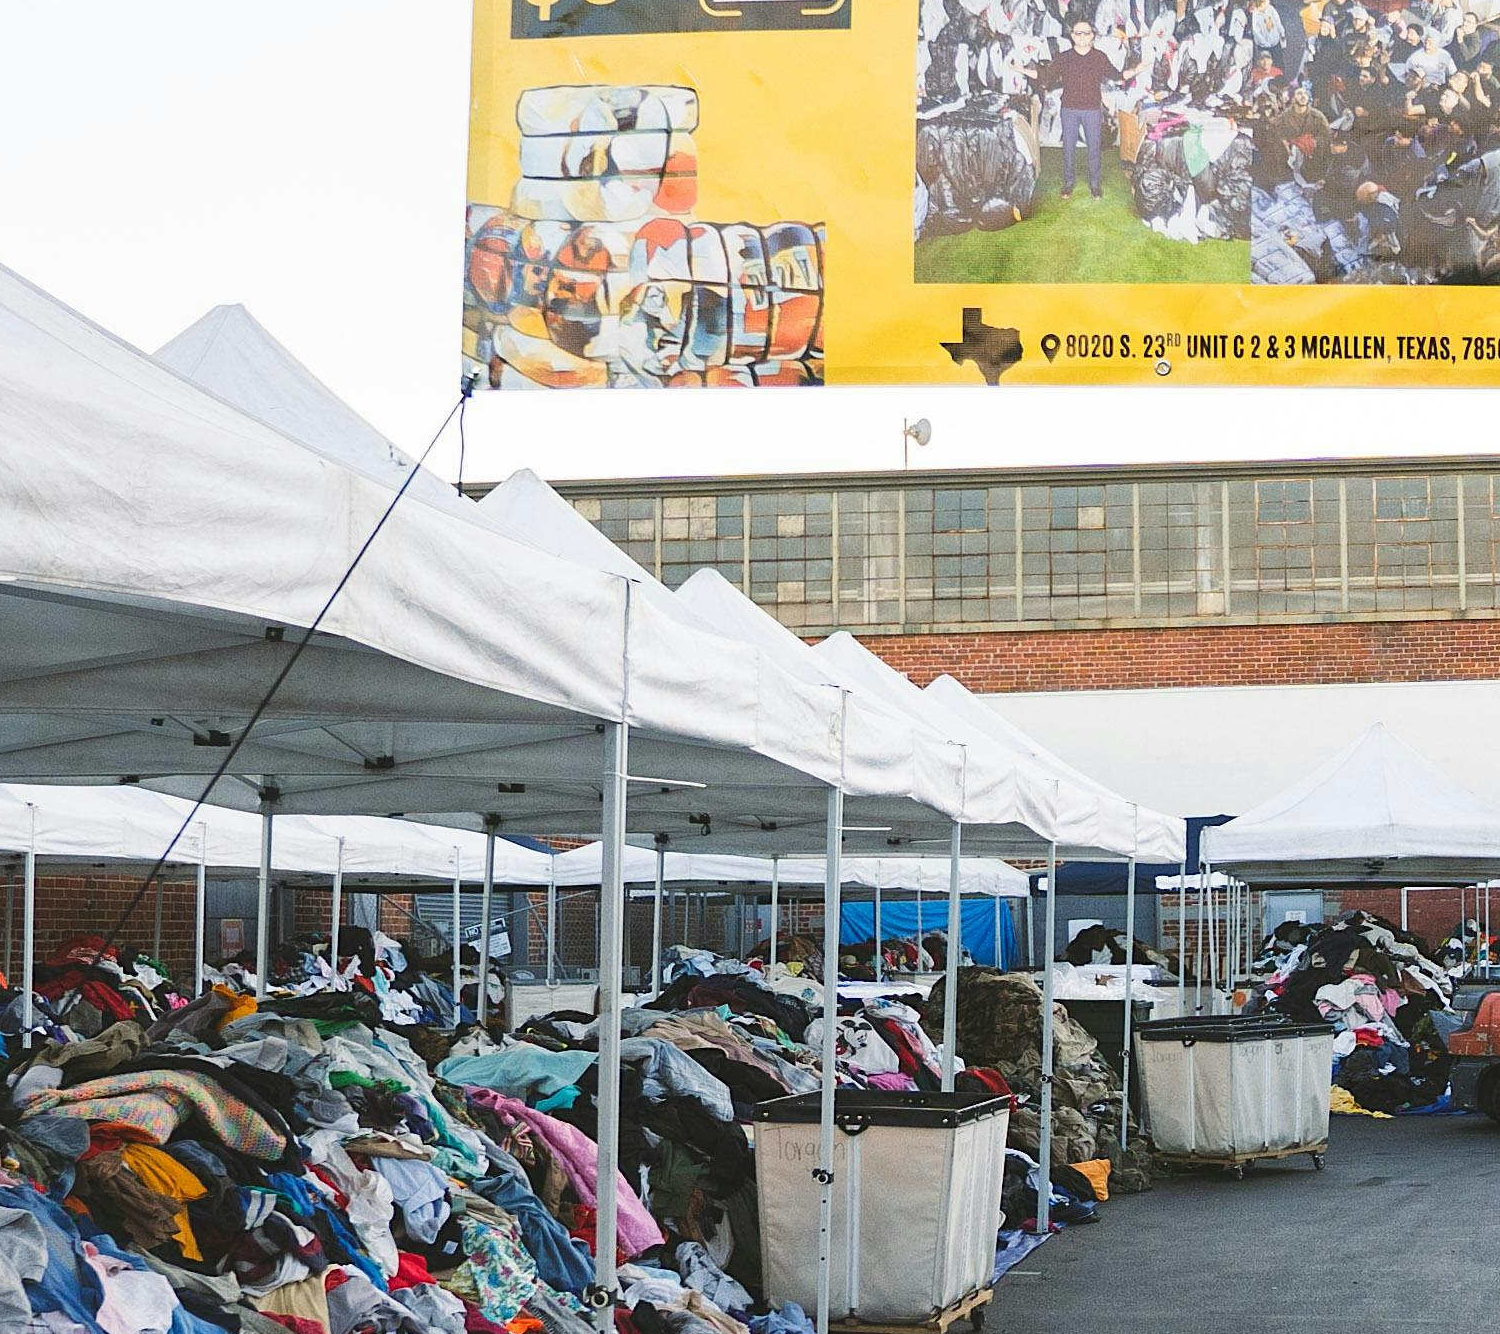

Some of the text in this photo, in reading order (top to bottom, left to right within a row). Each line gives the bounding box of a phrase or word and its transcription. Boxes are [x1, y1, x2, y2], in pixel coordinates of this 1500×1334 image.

[1120, 334, 1136, 358] S.
[1187, 335, 1228, 359] UNIT
[1234, 335, 1244, 359] C
[1251, 335, 1261, 359] 2
[1266, 335, 1279, 359] &
[1285, 335, 1295, 359] 3
[1301, 335, 1392, 363] MCALLEN,
[1397, 336, 1457, 364] TEXAS,
